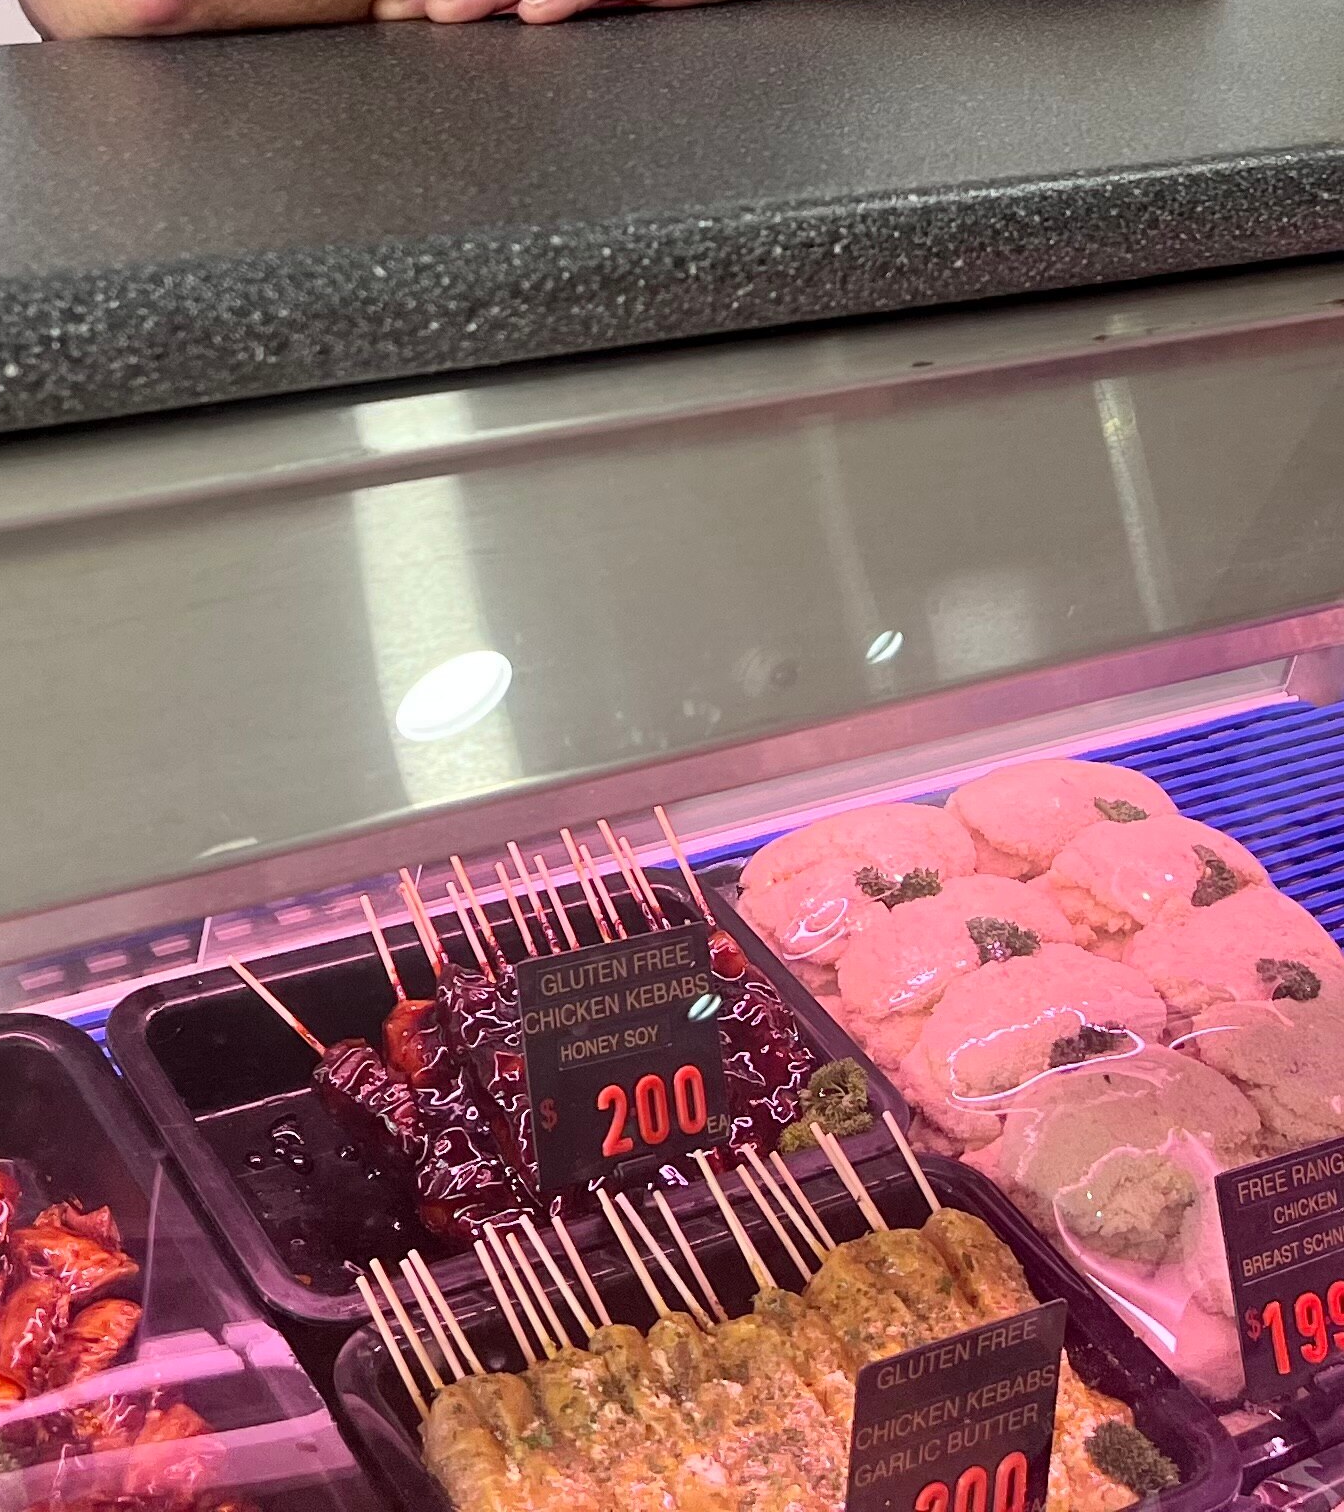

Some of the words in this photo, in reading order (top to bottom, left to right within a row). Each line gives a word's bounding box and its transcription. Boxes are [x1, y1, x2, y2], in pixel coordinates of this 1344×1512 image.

[540, 957, 627, 997] GLUTEN
[633, 943, 690, 974] FREE
[524, 998, 620, 1035] CHICKEN
[626, 974, 709, 1013] KEBABS
[561, 1033, 620, 1062] HONEY
[624, 1025, 659, 1048] SOY
[597, 1064, 707, 1157] 200
[1238, 1170, 1288, 1205] FREE
[1274, 1189, 1338, 1224] CHICKEN
[1242, 1242, 1300, 1277] BREAST
[877, 1340, 970, 1390] GLUTEN
[977, 1317, 1039, 1357] FREE
[855, 1396, 959, 1451] CHICKEN
[966, 1365, 1055, 1414] KEBABS
[854, 1439, 942, 1488] GARLIC
[946, 1402, 1039, 1454] BUTTER
